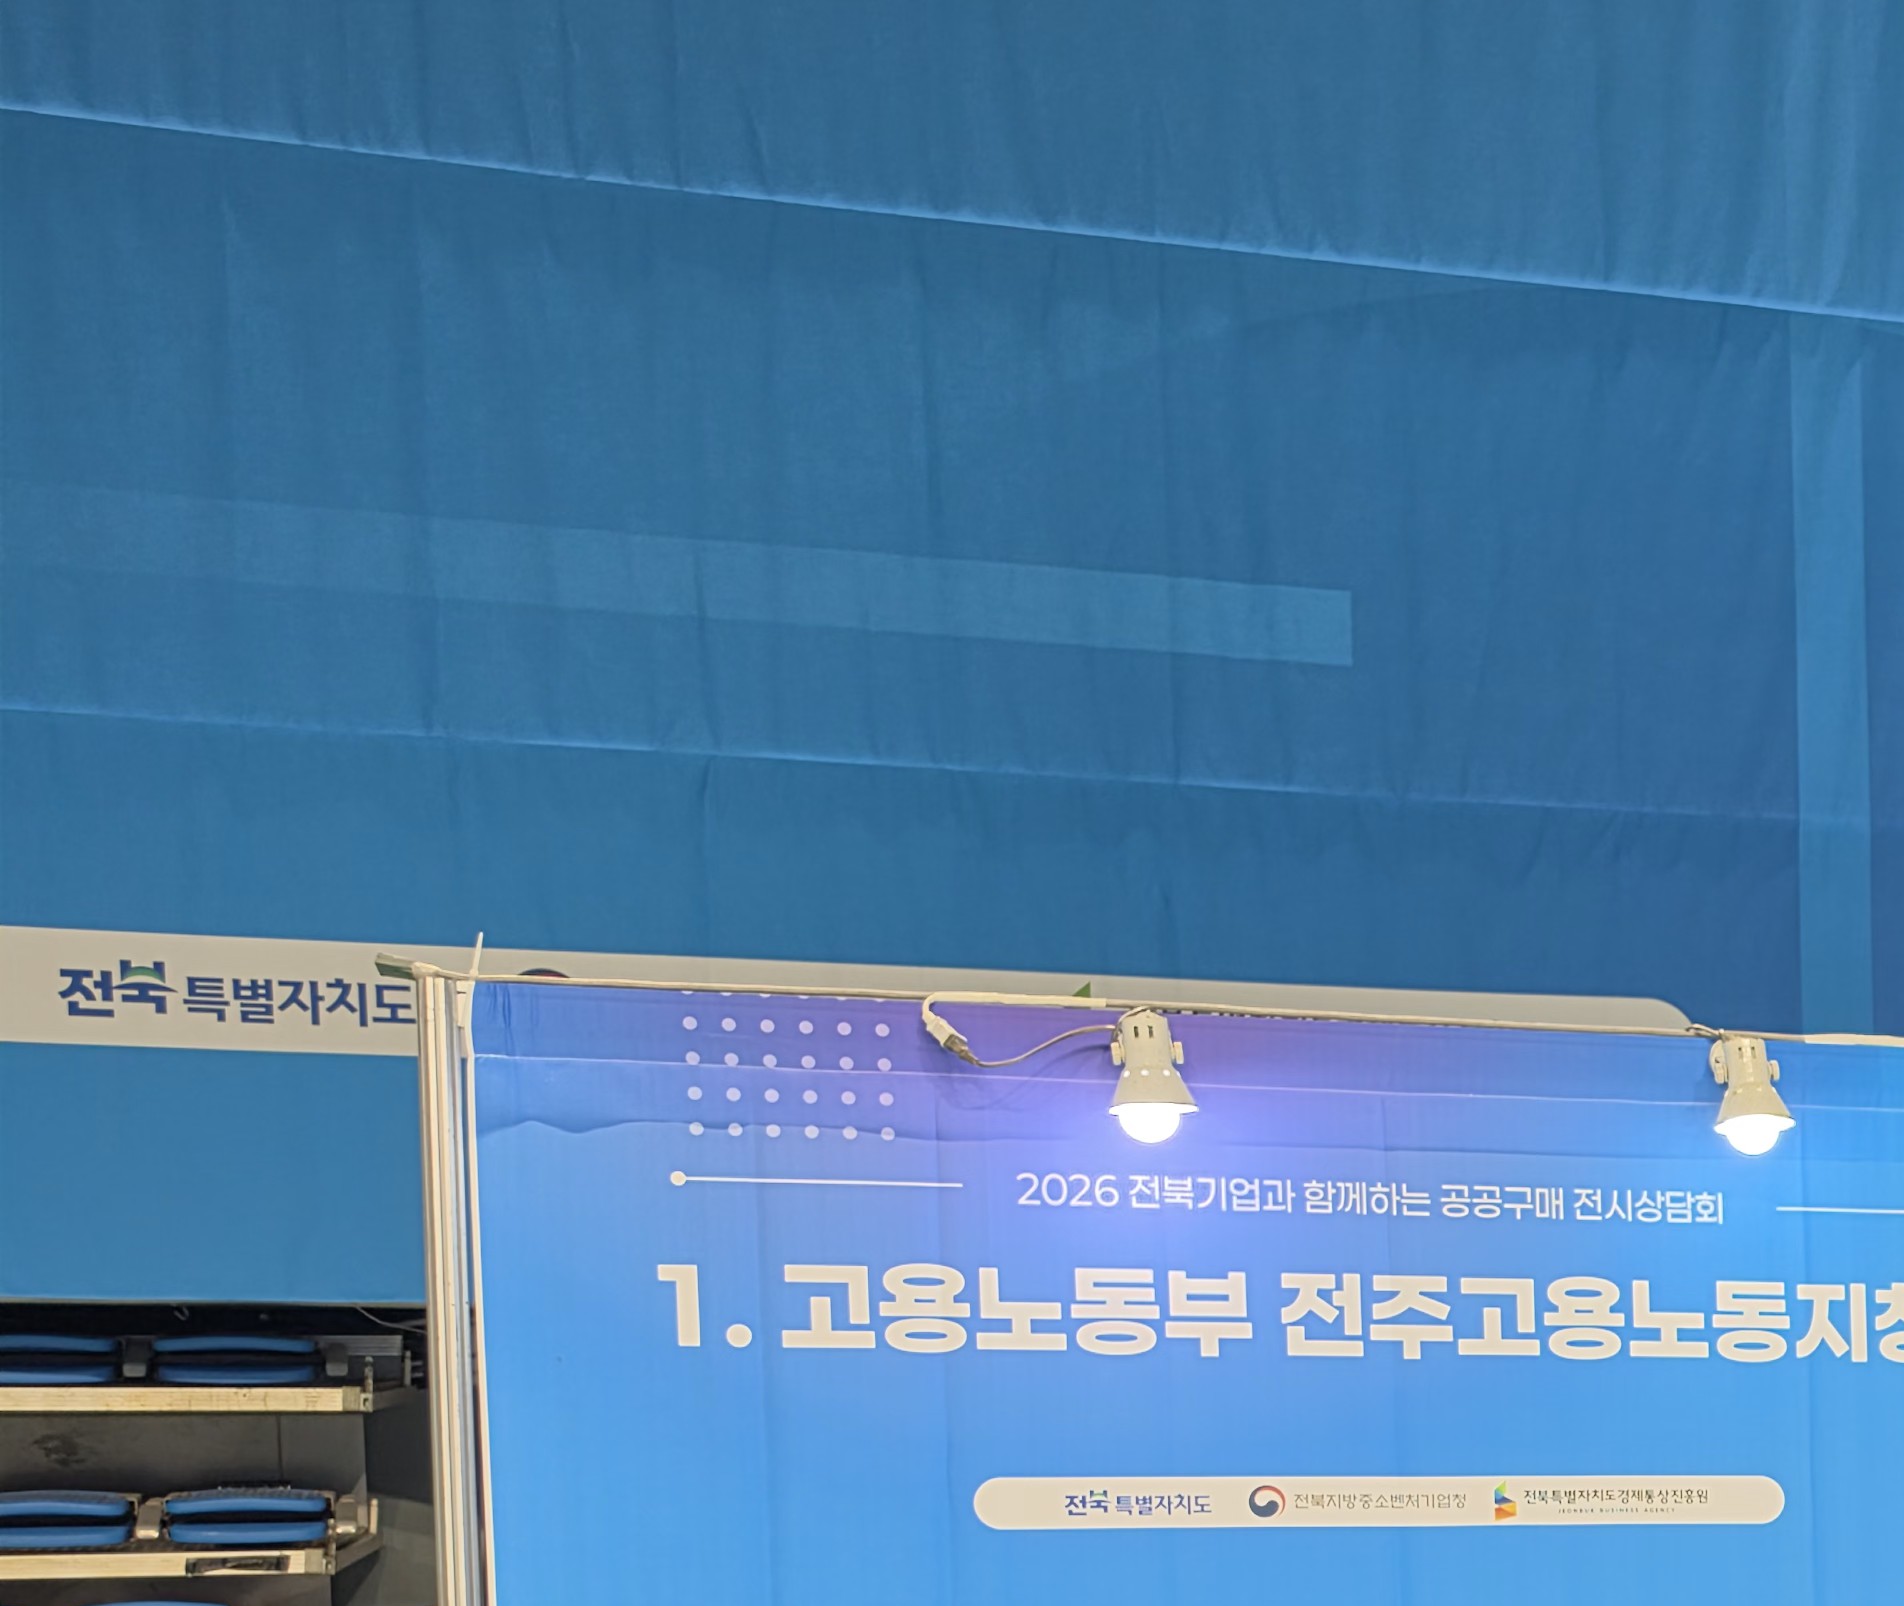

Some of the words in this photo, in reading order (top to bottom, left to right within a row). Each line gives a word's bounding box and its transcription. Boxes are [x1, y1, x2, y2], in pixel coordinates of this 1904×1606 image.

[58, 959, 178, 1018] 전북
[183, 976, 416, 1027] 특별자치도
[1016, 1172, 1119, 1208] 2026
[1128, 1174, 1296, 1214] 전북기업과
[1303, 1180, 1432, 1218] 함께하는
[1439, 1183, 1565, 1222] 공공구매
[1573, 1185, 1725, 1225] 전시상담회
[657, 1263, 753, 1348] 1.
[781, 1263, 1254, 1358] 고용노동부
[1064, 1489, 1111, 1516] 전북
[1114, 1494, 1213, 1516] 특별자치도
[1293, 1493, 1467, 1510] 전북지방중소벤처기업청
